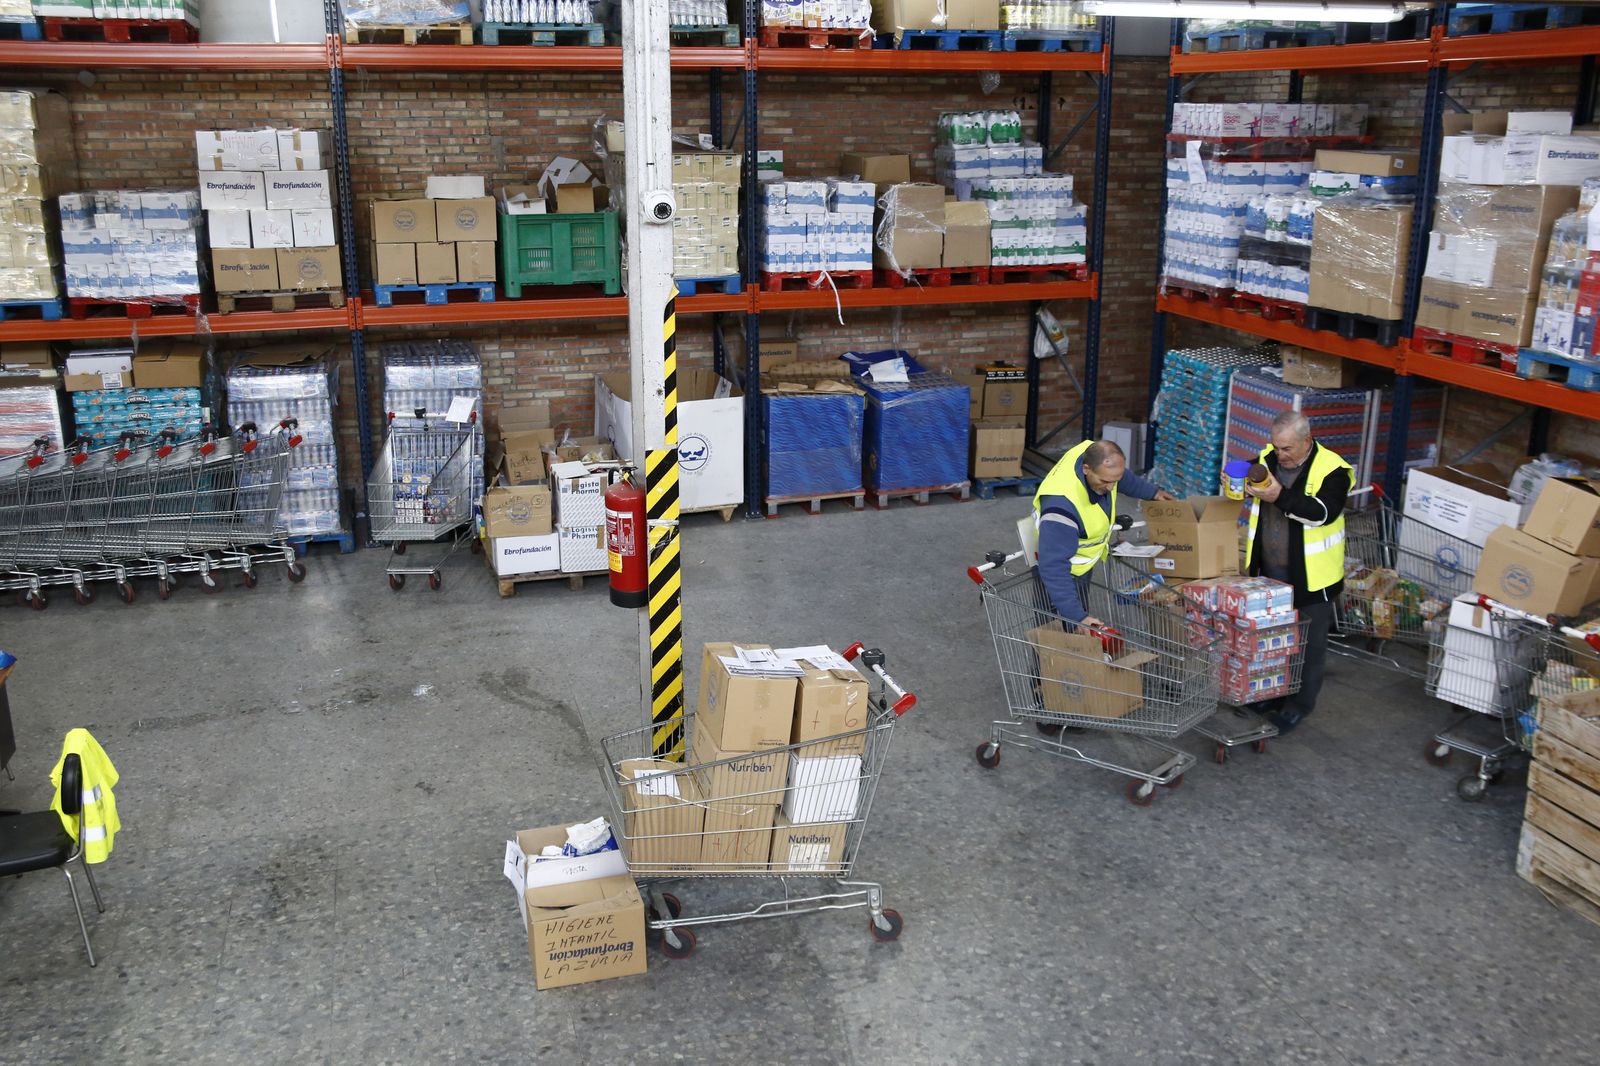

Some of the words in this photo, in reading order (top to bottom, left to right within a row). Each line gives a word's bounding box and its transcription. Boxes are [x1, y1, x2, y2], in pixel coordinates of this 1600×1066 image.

[1547, 150, 1599, 161] Ebrofundación
[206, 182, 256, 190] Ebrofundación
[272, 182, 322, 190] Ebrofundación
[504, 545, 552, 556] Ebrofundación
[845, 702, 858, 728] 6
[728, 762, 772, 772] Nutribén
[788, 834, 831, 844] Nutribén
[545, 914, 615, 936] HIGIENE
[545, 928, 618, 953] INFANTIL
[549, 941, 634, 962] Ebrofundación
